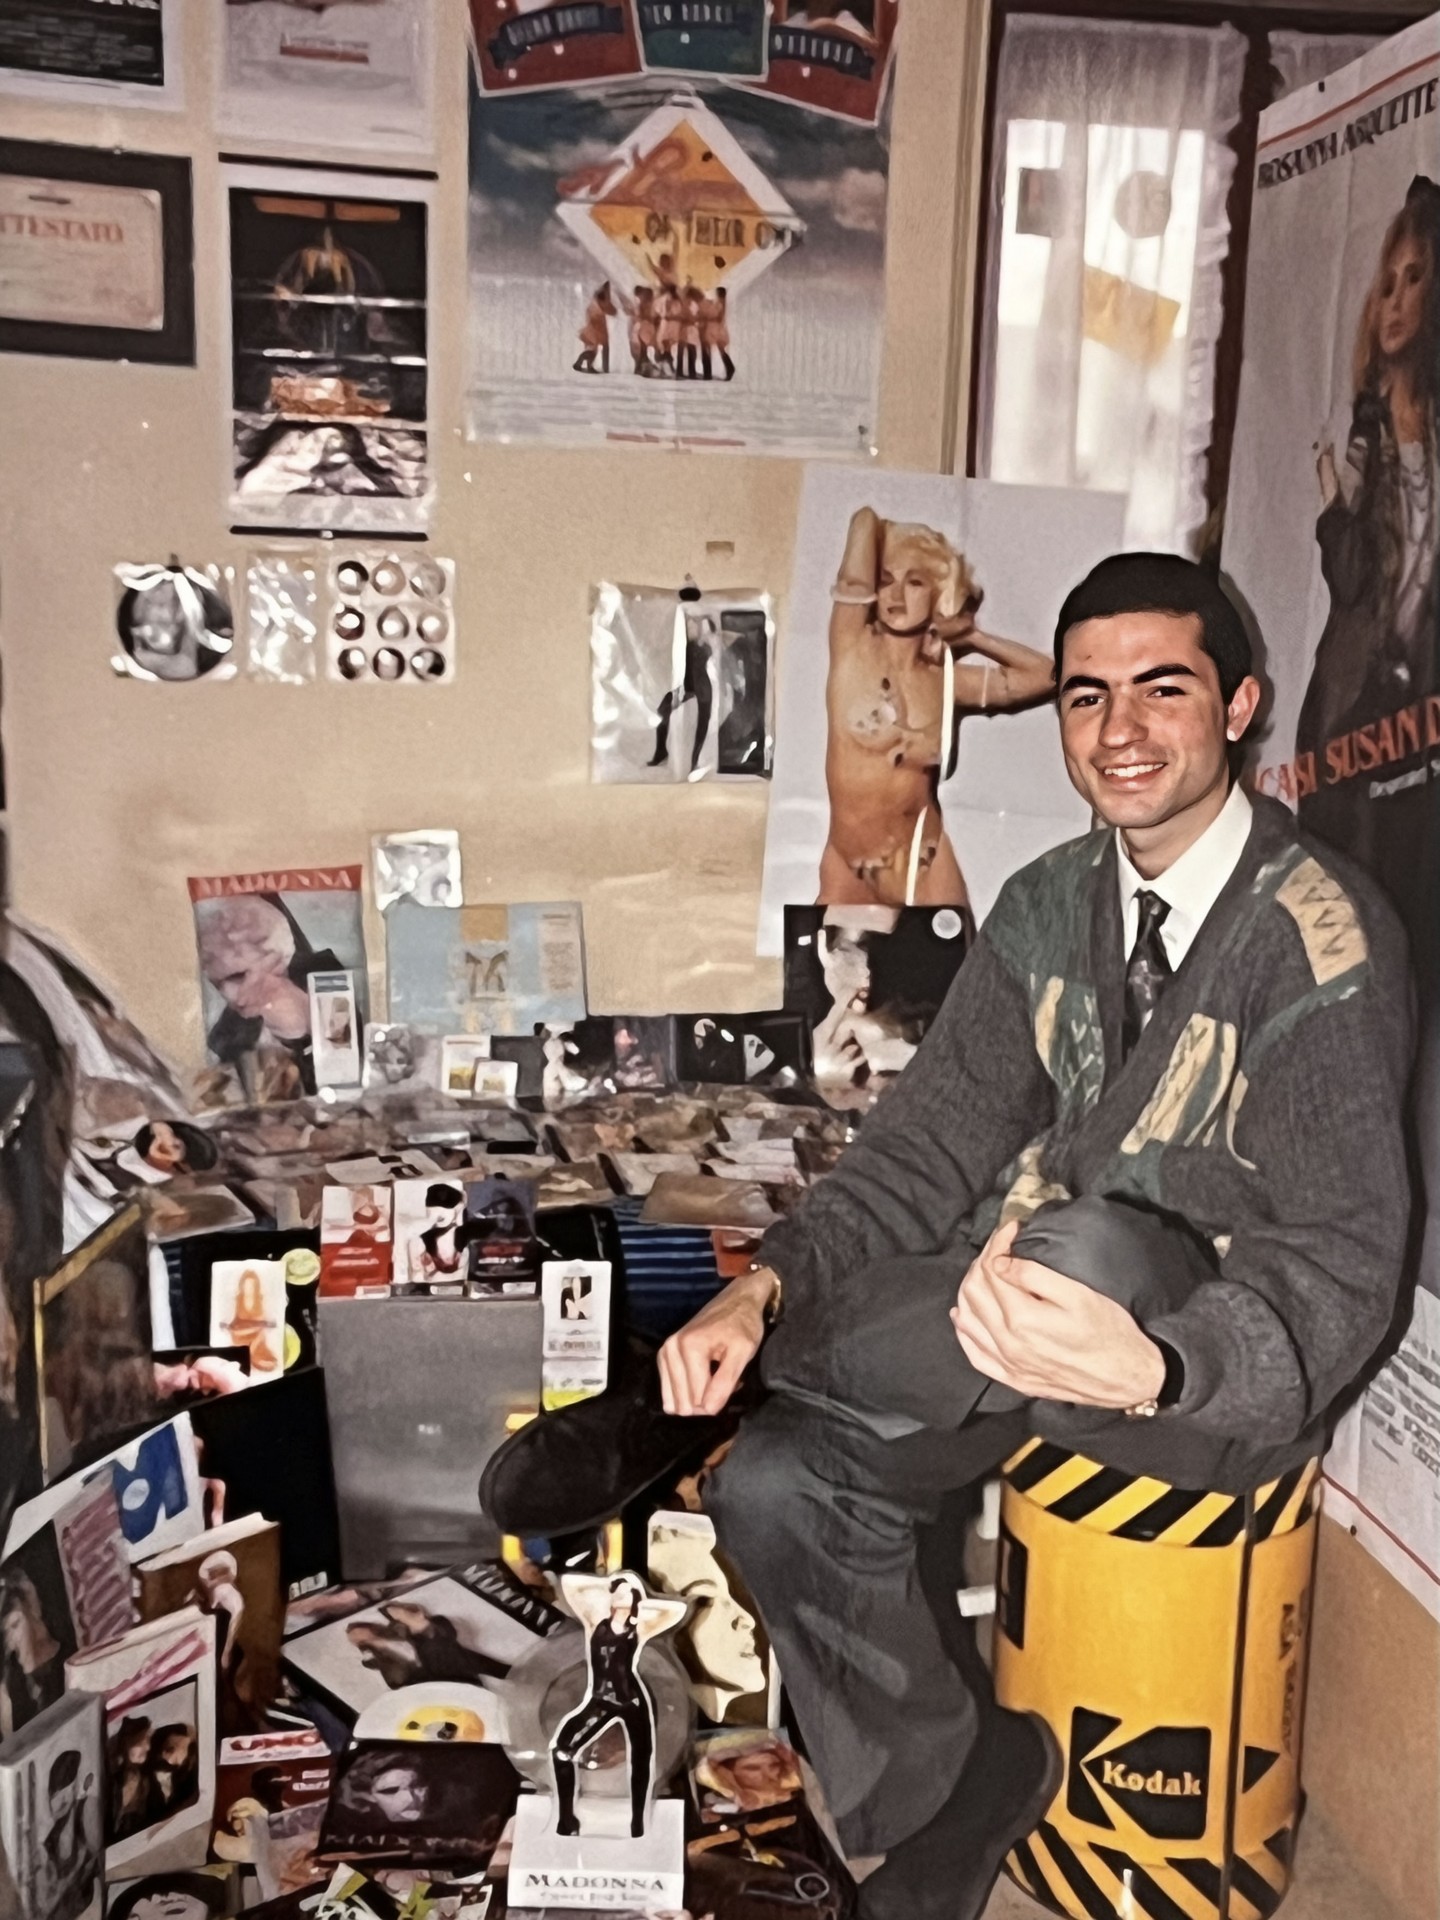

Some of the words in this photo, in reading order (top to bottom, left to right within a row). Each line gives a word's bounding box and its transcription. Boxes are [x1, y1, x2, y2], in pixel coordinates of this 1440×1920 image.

[1326, 705, 1420, 785] SUSAN
[1103, 1760, 1201, 1796] Kodak
[525, 1874, 665, 1891] MADONNA
